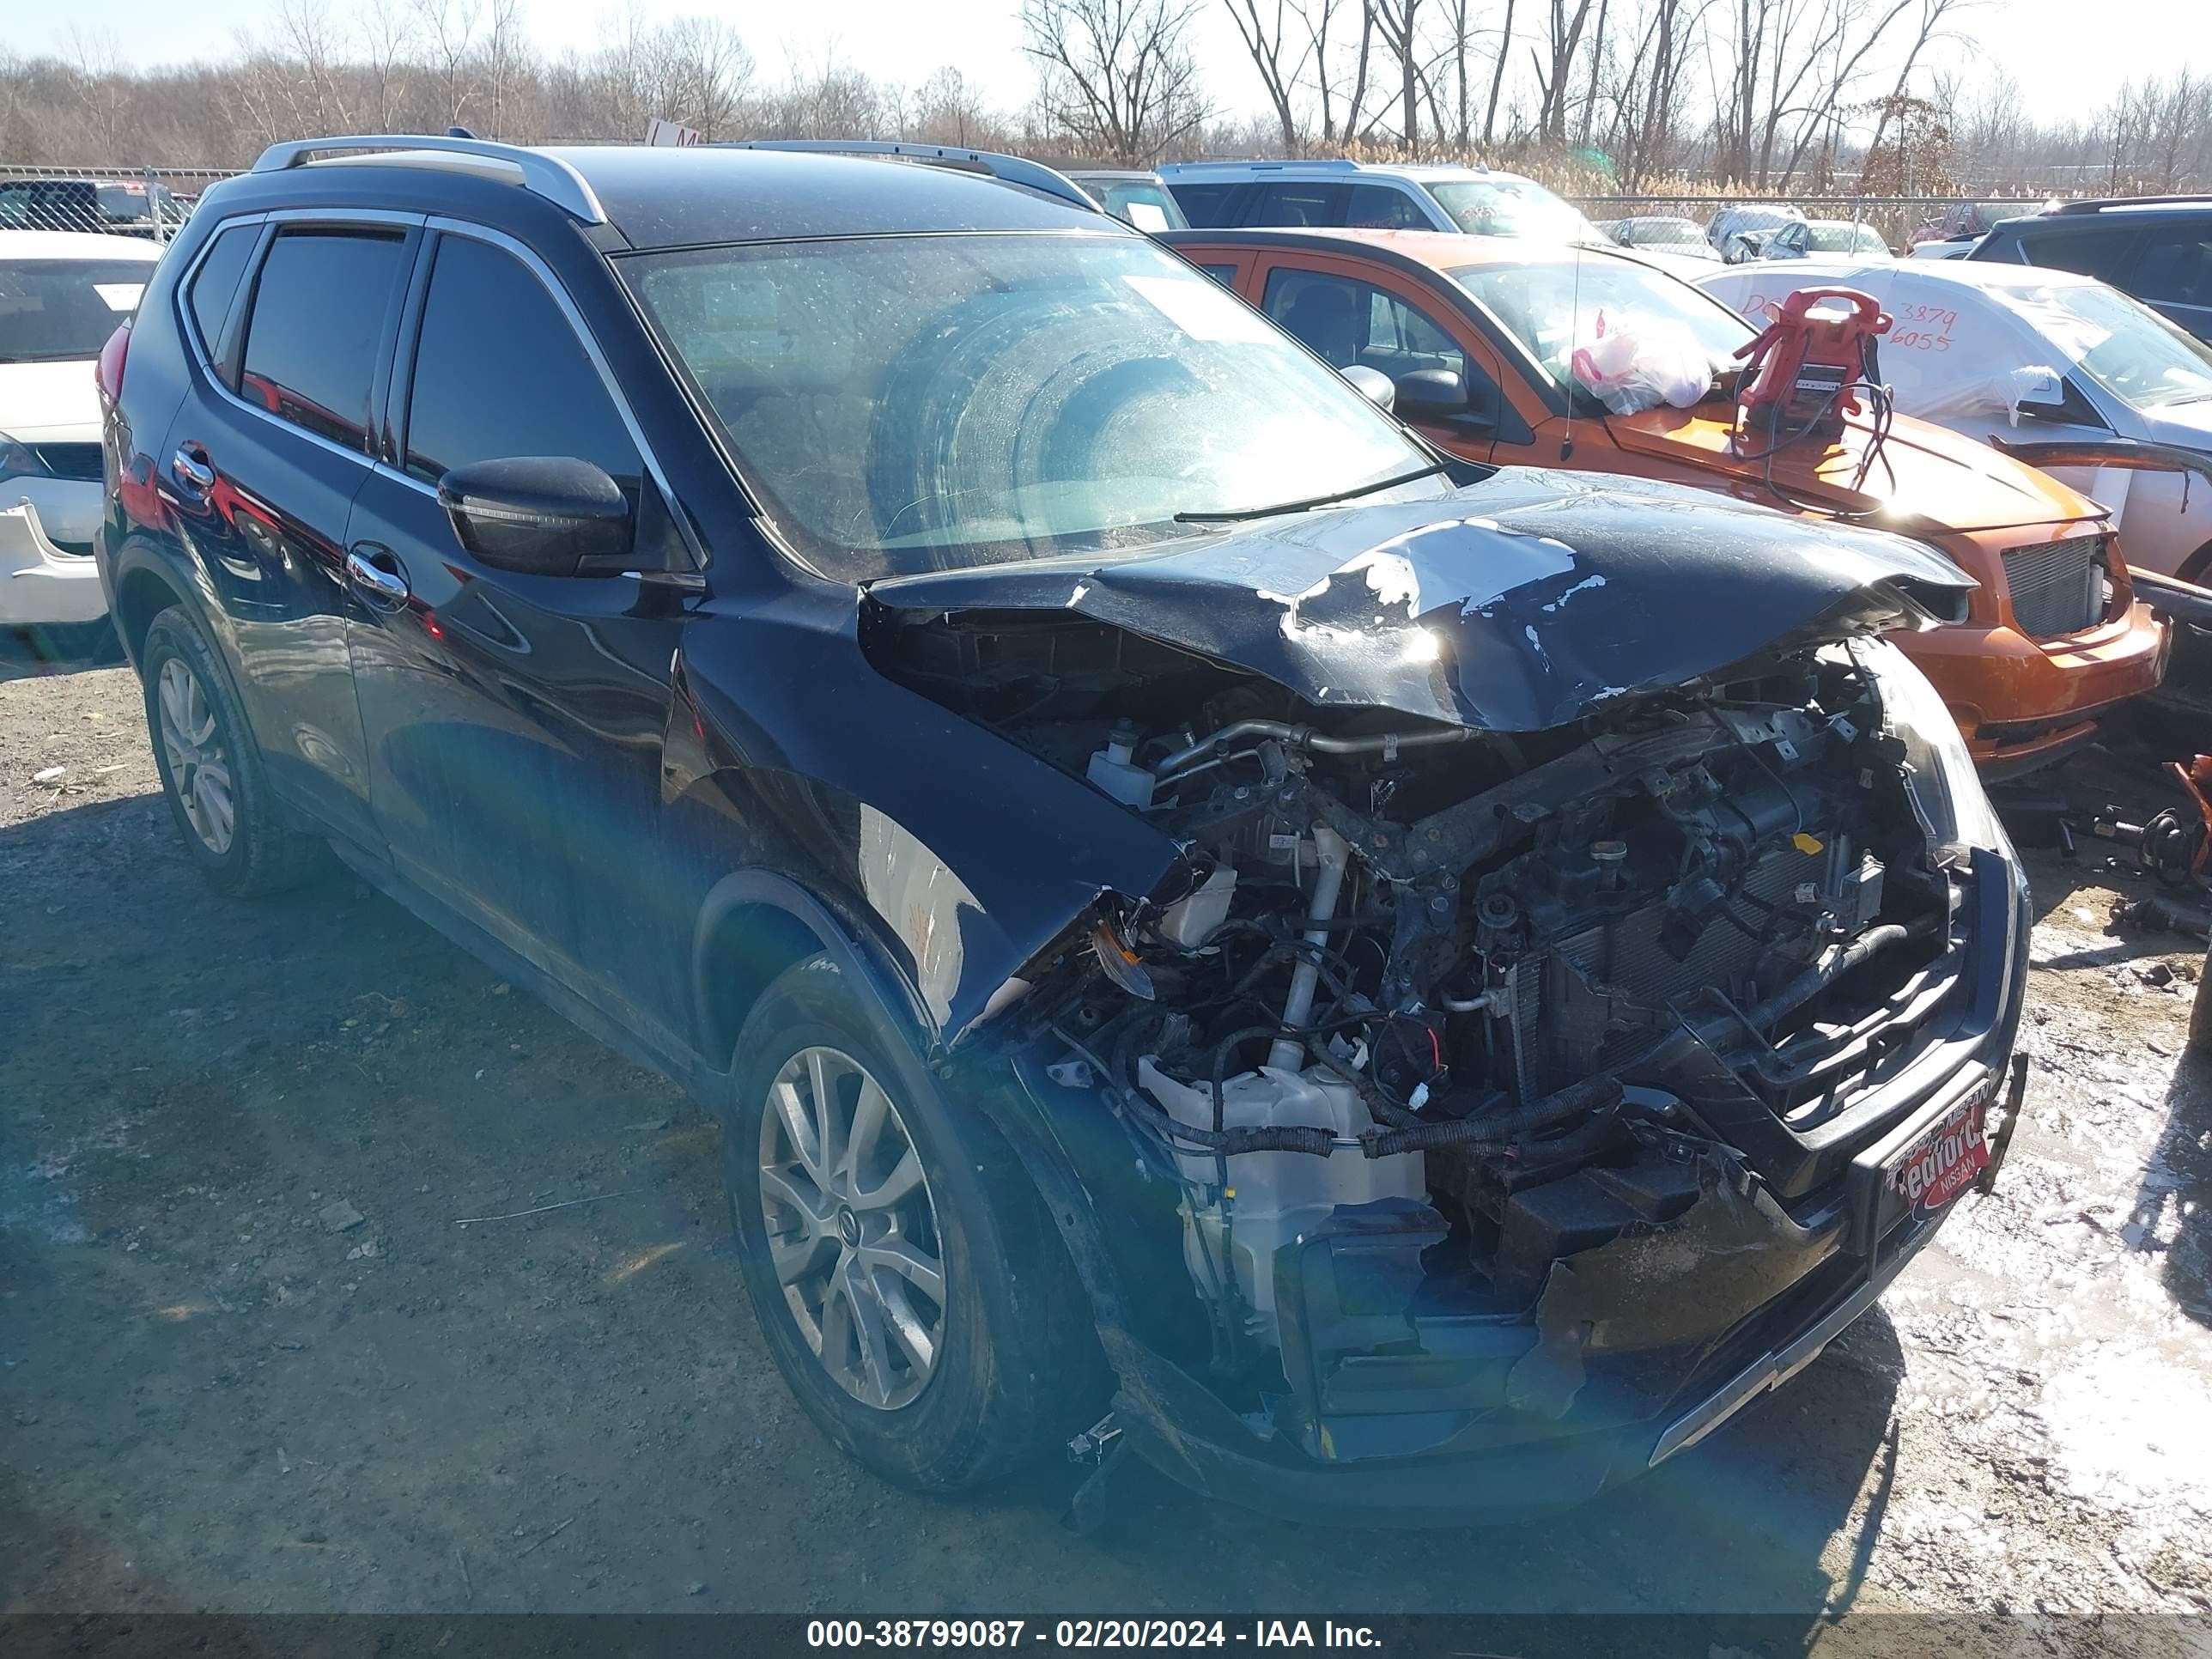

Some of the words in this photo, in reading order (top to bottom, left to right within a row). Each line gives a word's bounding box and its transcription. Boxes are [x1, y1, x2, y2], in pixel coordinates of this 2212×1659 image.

[1899, 303, 1957, 333] 3879
[1889, 326, 1956, 352] 6055
[1940, 1153, 1976, 1194] NISSAN
